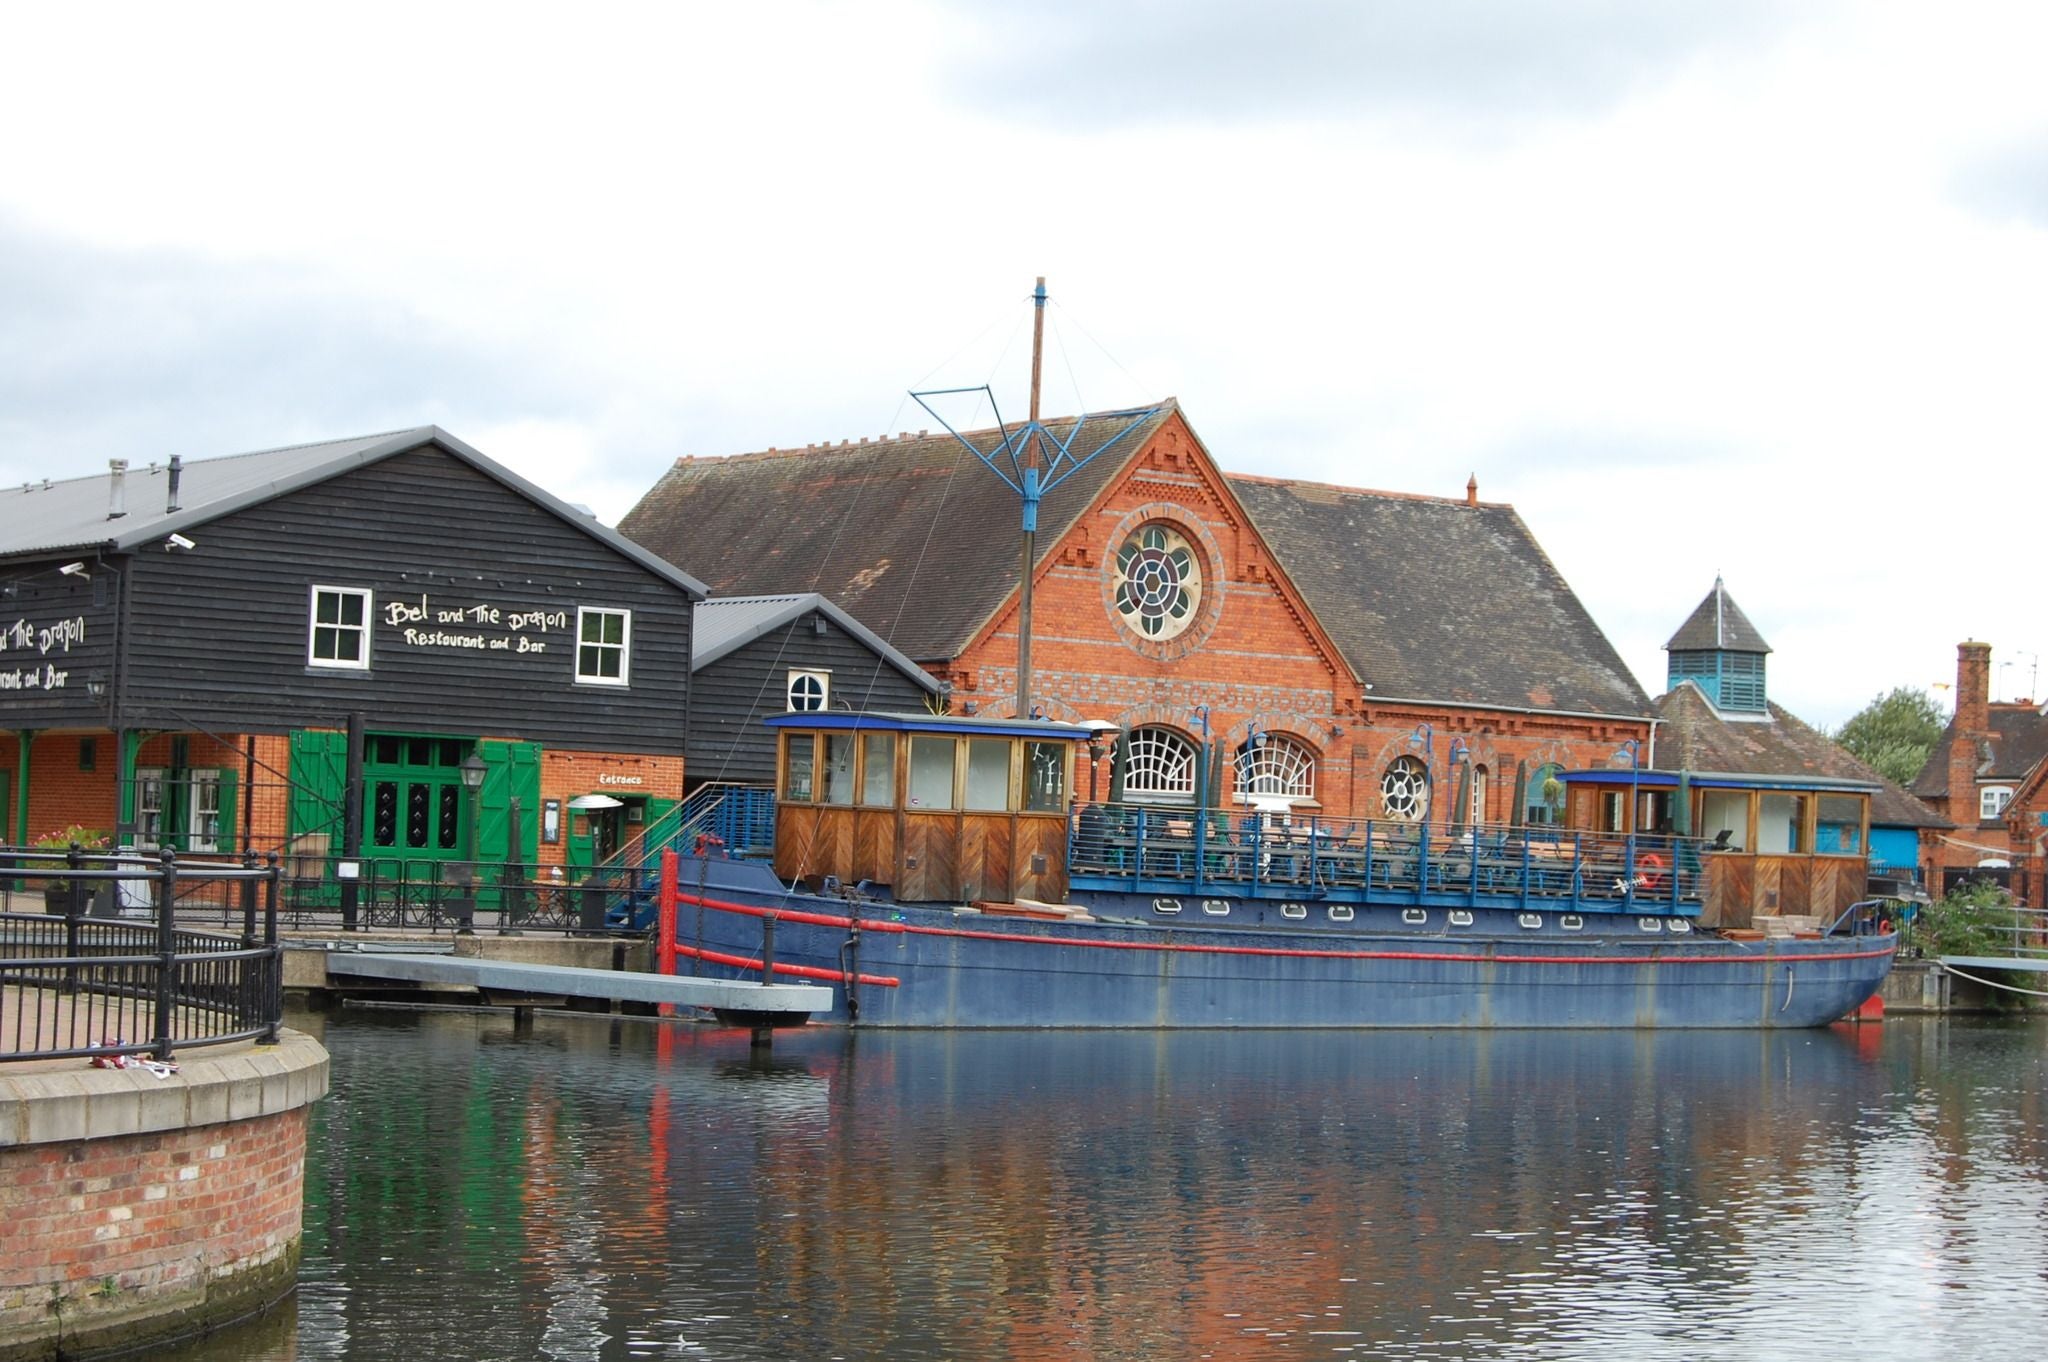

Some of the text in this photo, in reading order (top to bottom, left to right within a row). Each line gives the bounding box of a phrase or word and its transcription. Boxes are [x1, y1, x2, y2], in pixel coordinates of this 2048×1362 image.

[385, 594, 566, 632] Bel and The Dragon
[8, 618, 34, 649] The
[39, 616, 84, 655] Dragon
[404, 628, 546, 653] Restaurant and Bar
[0, 663, 68, 690] rant and Bar
[599, 773, 642, 785] Entrance
